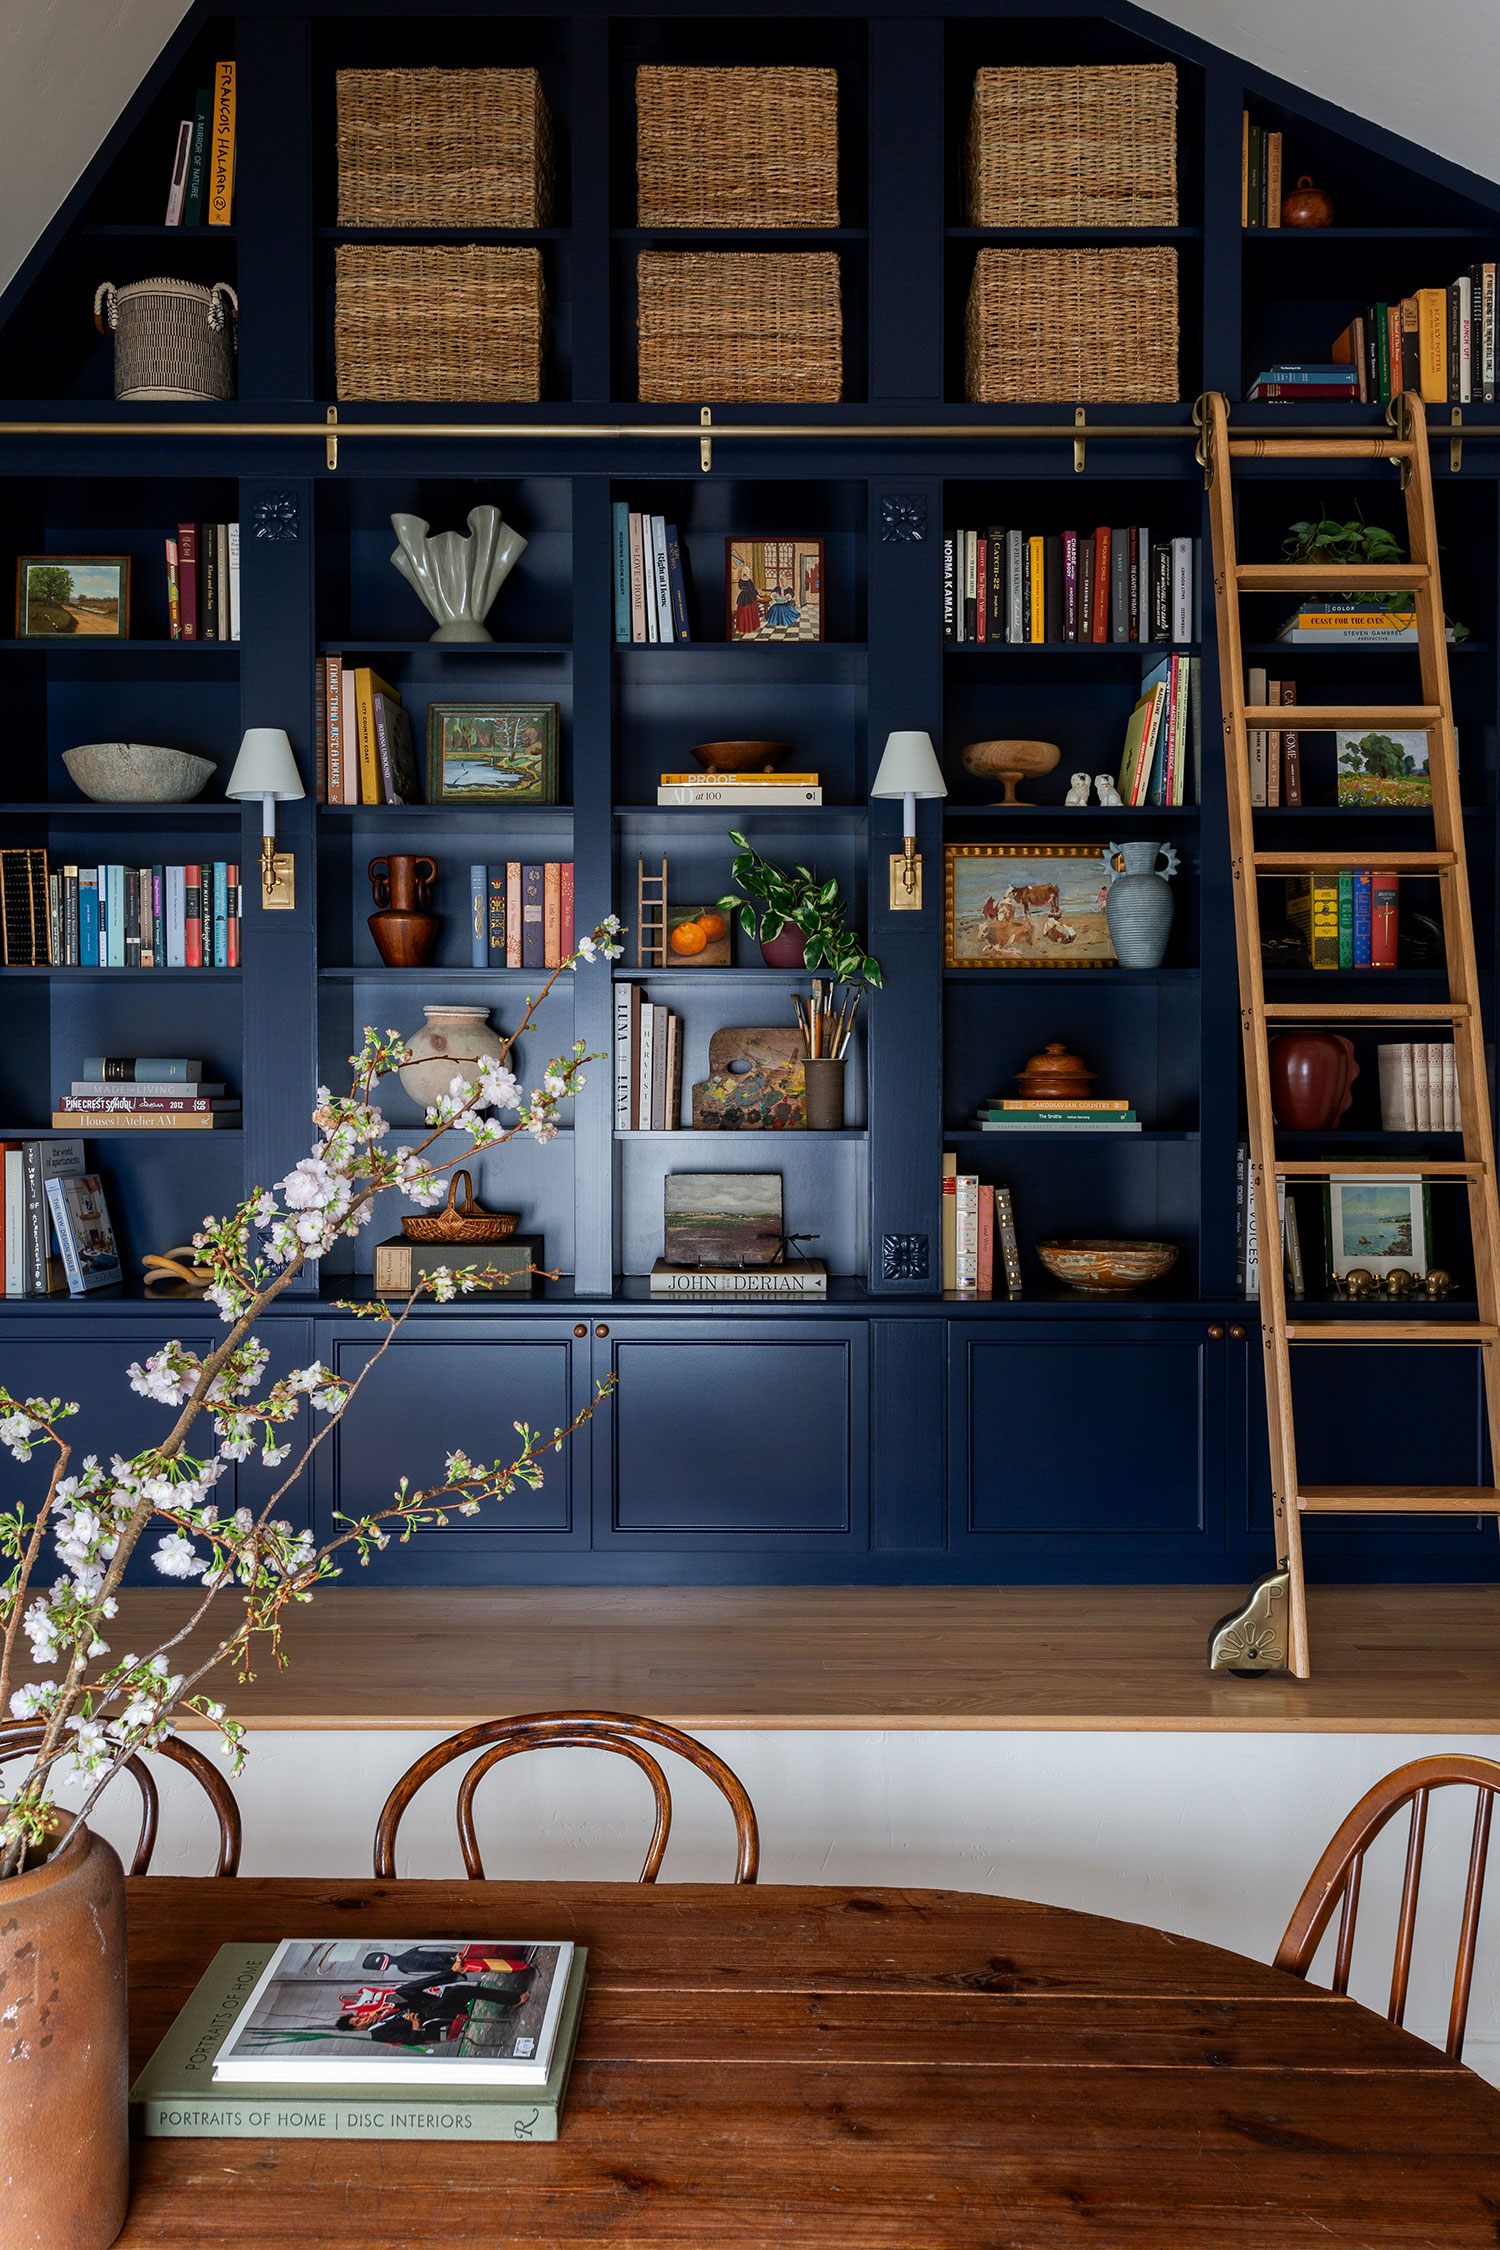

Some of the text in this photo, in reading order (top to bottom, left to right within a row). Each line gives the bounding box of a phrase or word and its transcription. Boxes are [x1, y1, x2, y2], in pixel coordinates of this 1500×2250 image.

[217, 64, 233, 138] FRANÇOIS
[194, 122, 204, 155] MIRROR
[194, 155, 202, 166] OF
[190, 168, 201, 199] NATURE
[1013, 536, 1020, 548] ON
[633, 554, 641, 576] LOVE
[657, 553, 666, 575] Right
[992, 542, 1001, 590] CATCH-22
[659, 575, 665, 583] at
[944, 540, 953, 623] NORMA KAMALI
[634, 584, 642, 610] HOME
[1310, 617, 1384, 625] FEAST FOR THE EYES
[329, 664, 339, 694] MORE
[330, 696, 339, 722] THAN
[1154, 687, 1164, 715] MADELINE
[331, 724, 339, 748] JUST
[1286, 731, 1297, 761] HOME
[378, 723, 390, 778] IKEBANA UNBOUND
[331, 759, 339, 788] HOUSE
[688, 775, 737, 784] PROOF
[670, 788, 722, 804] AD at 100
[617, 1004, 628, 1041] LUNA
[94, 1085, 175, 1095] MADE LIVING
[617, 1075, 628, 1112] LUNA
[66, 1100, 82, 1109] PINE
[82, 1100, 105, 1109] CREST
[105, 1100, 133, 1109] SCHOOL
[169, 1101, 184, 1109] 2012
[80, 1115, 177, 1126] Houses Atelier AM
[52, 1145, 73, 1156] the world
[1236, 1163, 1244, 1181] CREST
[53, 1198, 75, 1273] THE NEW DESIGN RULES
[1248, 1211, 1259, 1265] VOICES
[667, 1275, 717, 1290] JOHN
[733, 1275, 805, 1290] DERIAN
[1264, 1584, 1284, 1619] P
[185, 1960, 263, 2070] PORTRAITS OF HOME
[159, 2111, 327, 2127] PORTRAITS OF HOME
[347, 2114, 473, 2129] DISC INTERIORS
[514, 2107, 540, 2138] R
